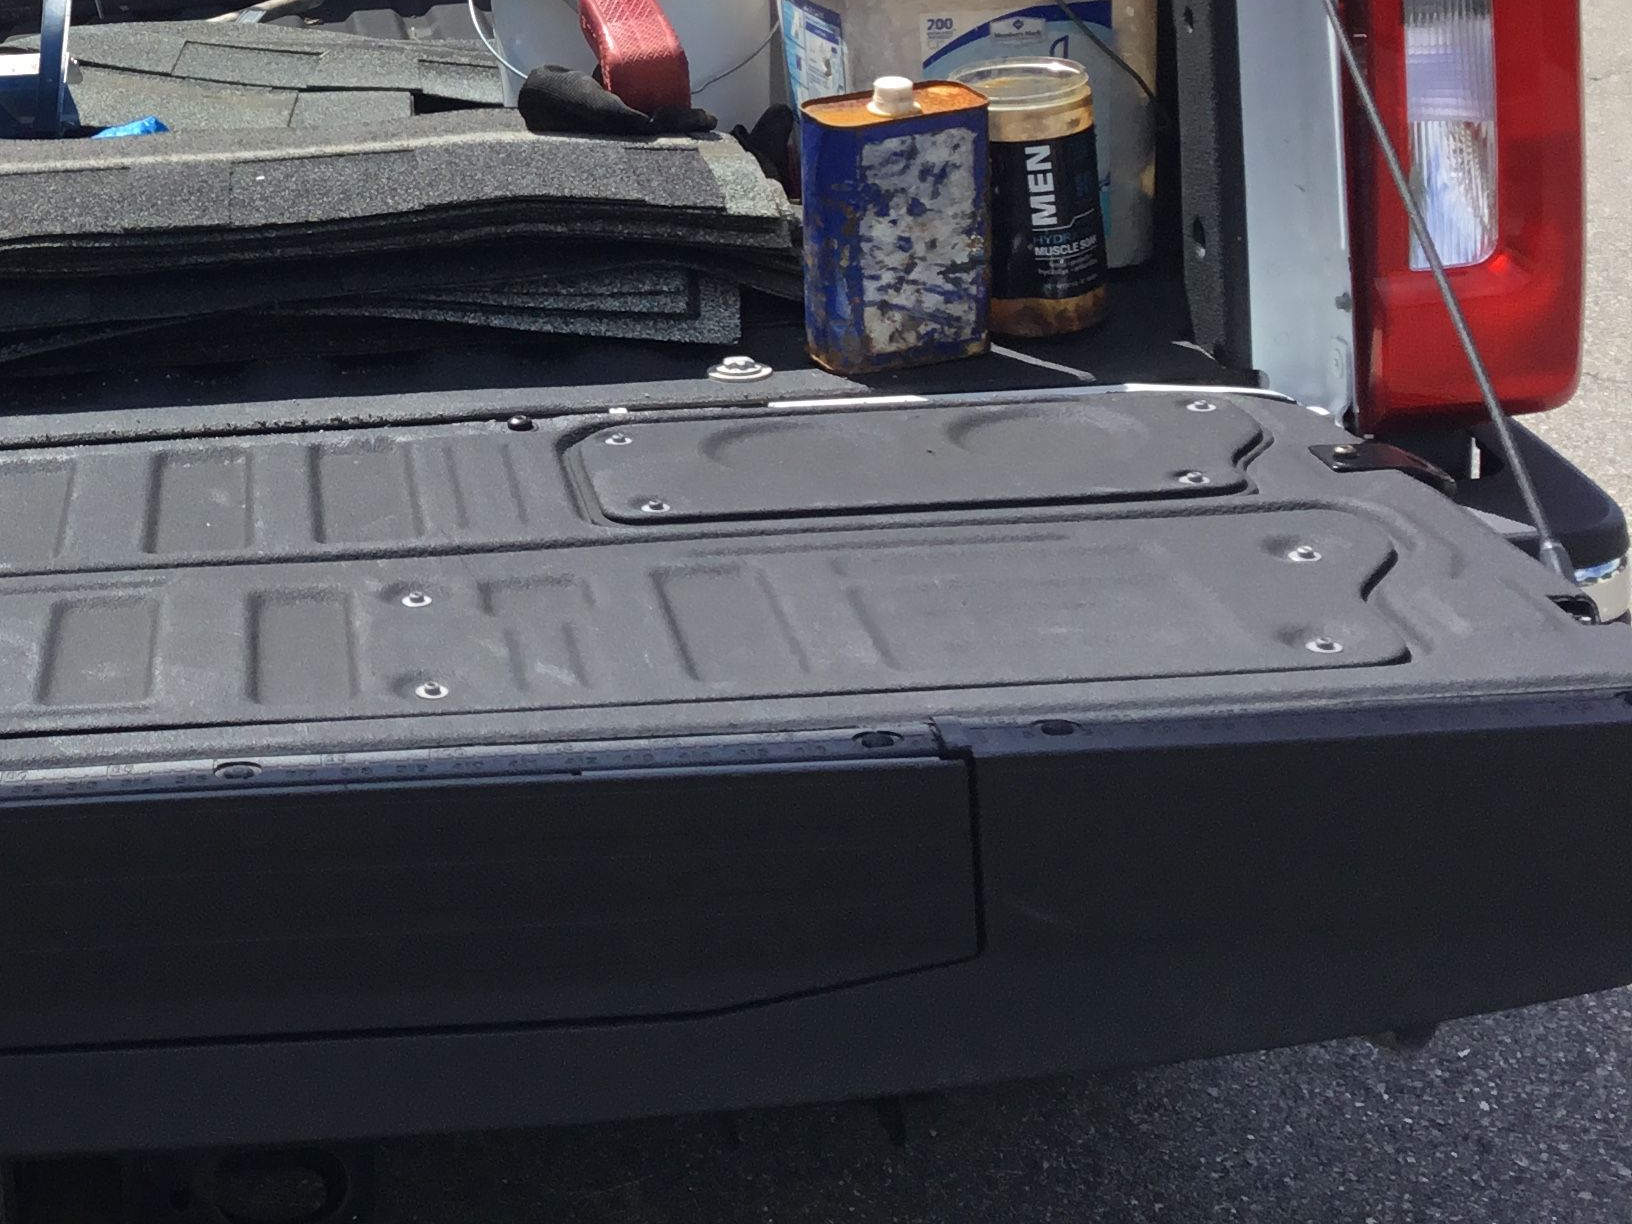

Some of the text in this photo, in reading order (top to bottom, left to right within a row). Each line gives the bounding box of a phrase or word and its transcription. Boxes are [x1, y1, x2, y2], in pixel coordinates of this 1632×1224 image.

[927, 17, 954, 31] 700
[1024, 145, 1058, 226] MEN
[1034, 242, 1079, 256] MUSCLE
